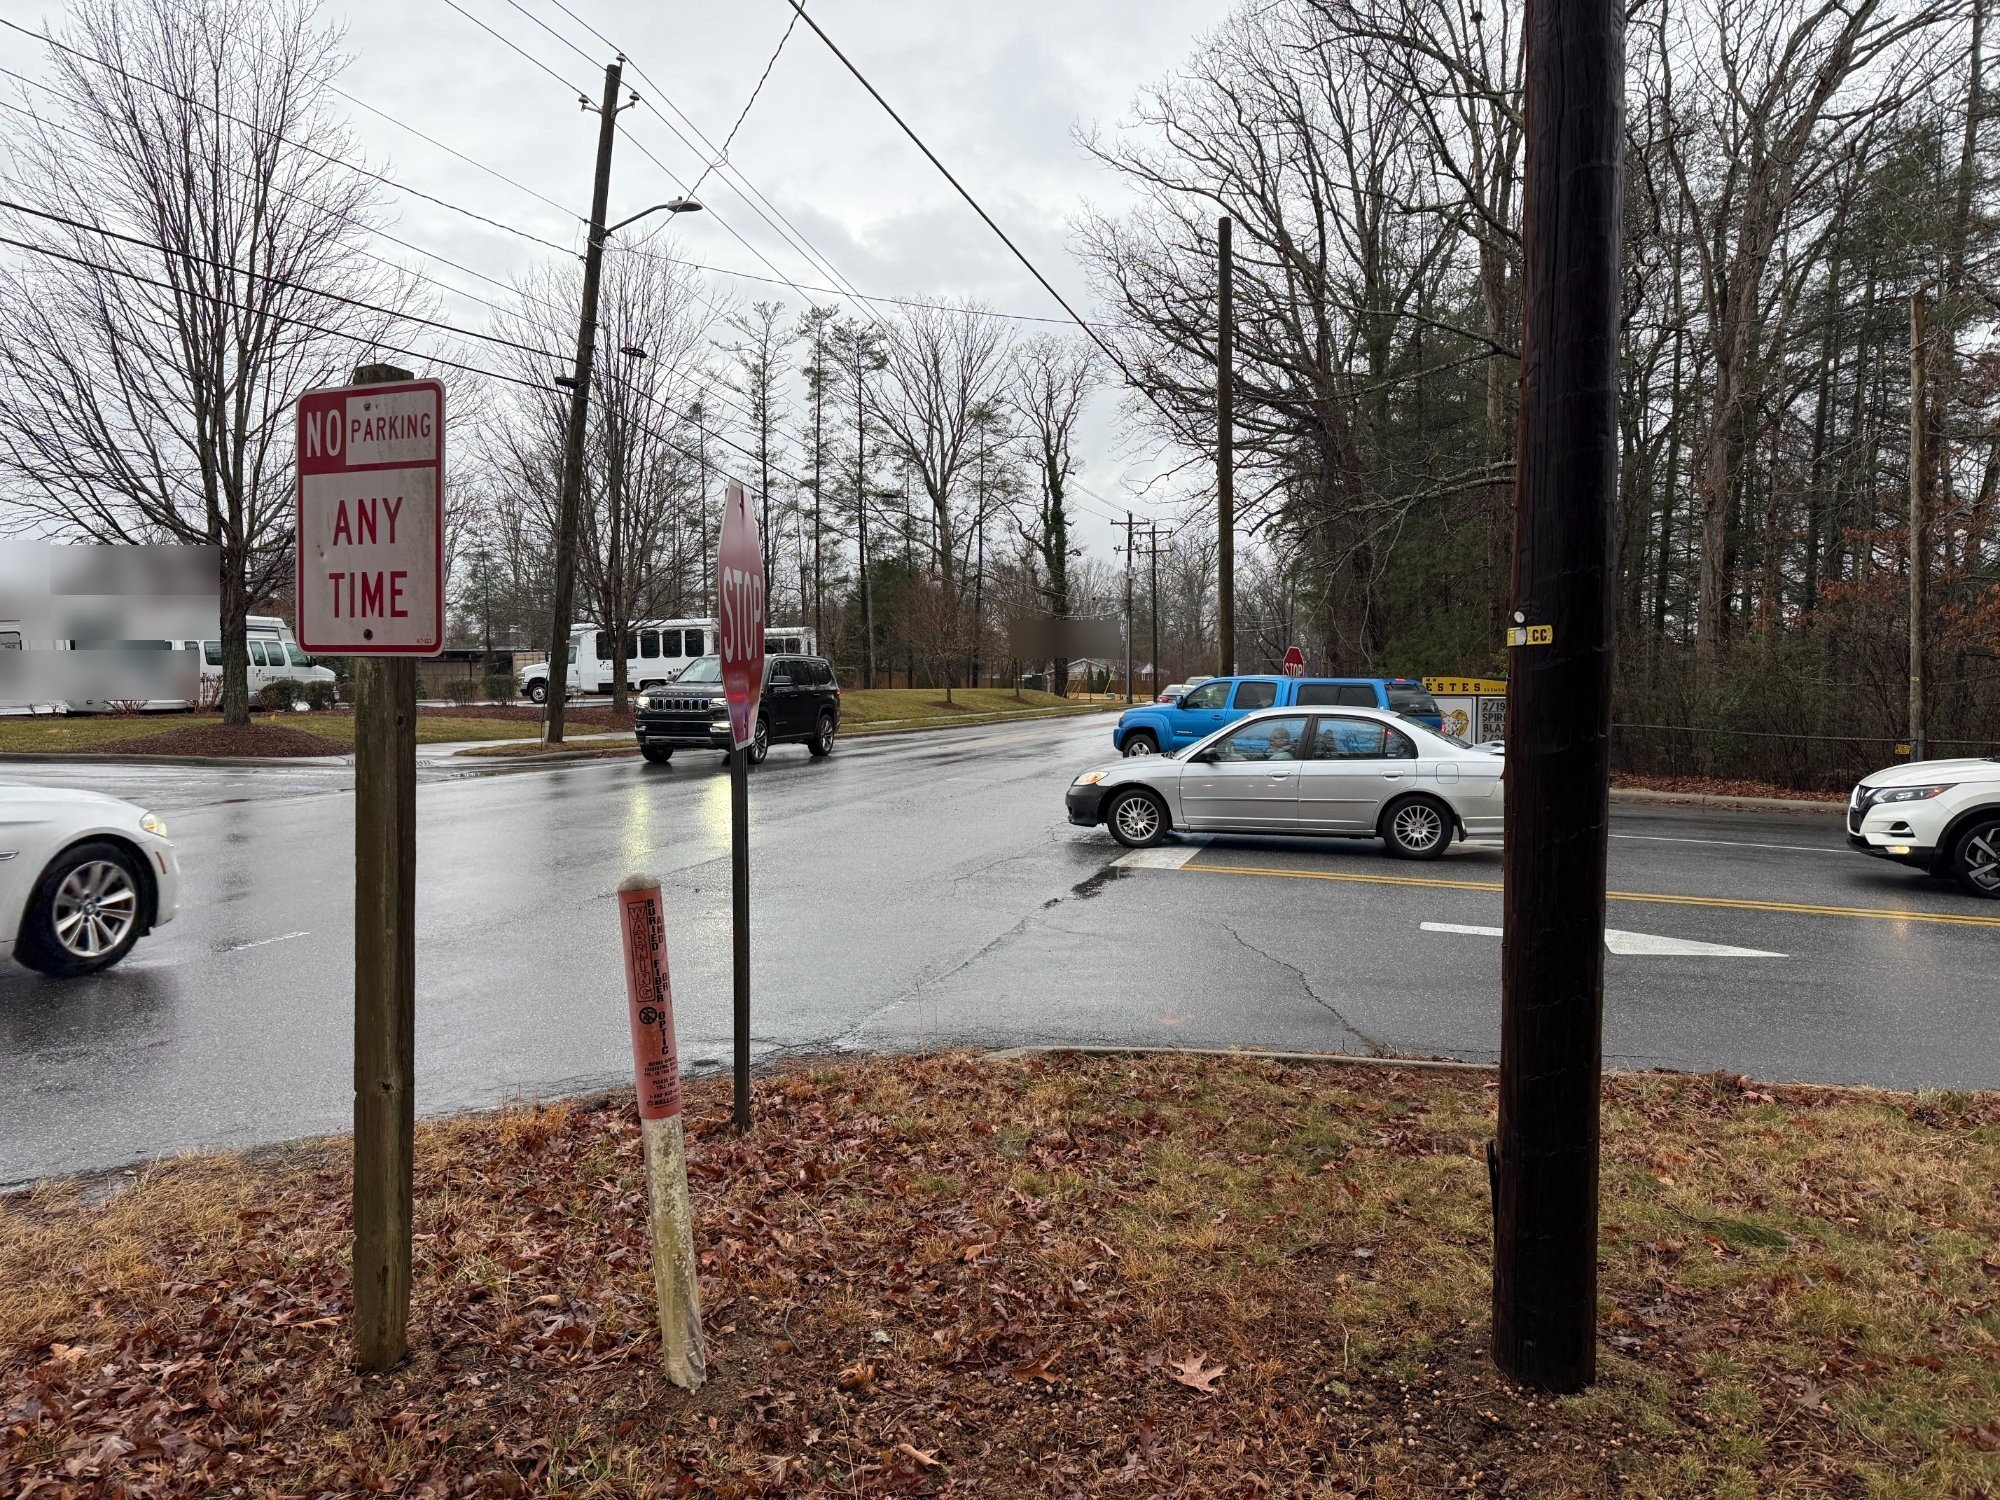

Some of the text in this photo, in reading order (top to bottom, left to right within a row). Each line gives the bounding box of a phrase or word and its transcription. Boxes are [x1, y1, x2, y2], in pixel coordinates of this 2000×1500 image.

[306, 408, 431, 458] NO PARKING
[333, 496, 403, 546] ANY
[328, 570, 409, 618] TIME
[723, 565, 762, 663] STOP
[1532, 628, 1548, 642] CC
[1284, 662, 1303, 677] STOP
[1426, 683, 1480, 692] ESTES
[1482, 702, 1506, 711] 2/19
[629, 906, 653, 999] WARNING
[647, 899, 669, 1055] BURIED FIBER OPTIC
